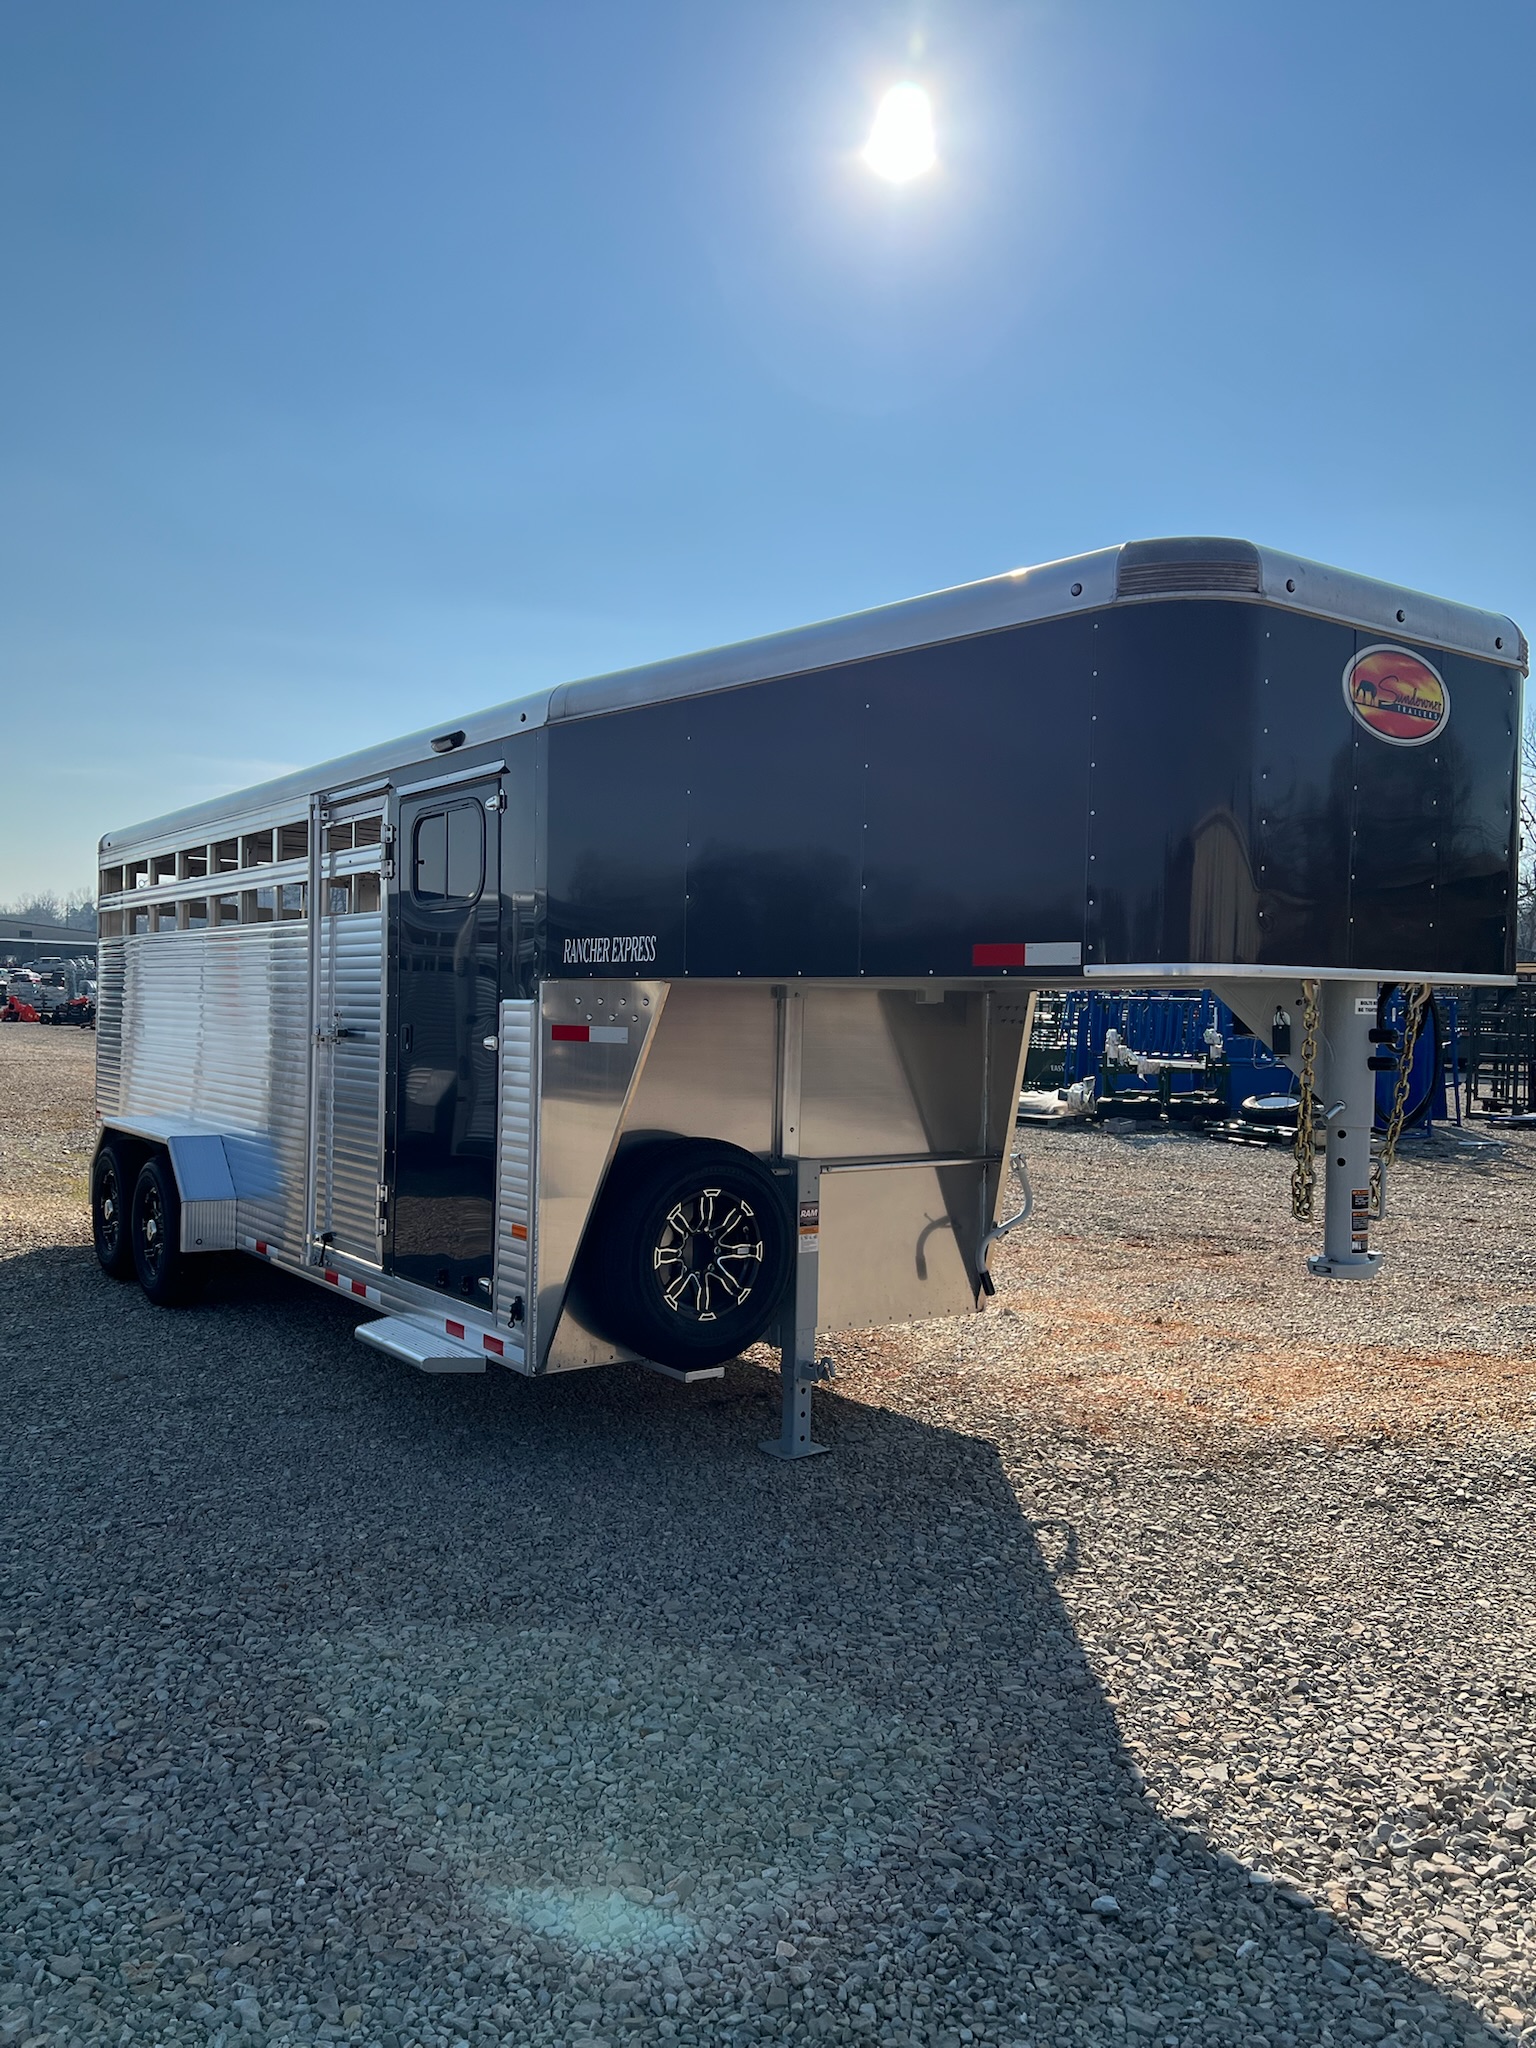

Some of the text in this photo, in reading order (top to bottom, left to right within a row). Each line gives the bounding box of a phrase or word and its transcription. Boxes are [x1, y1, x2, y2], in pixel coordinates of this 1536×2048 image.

[1378, 675, 1441, 710] Sundowner
[1397, 704, 1438, 719] TRAILERS
[563, 935, 657, 963] RANCHER EXPRESS
[800, 1209, 818, 1218] RAM
